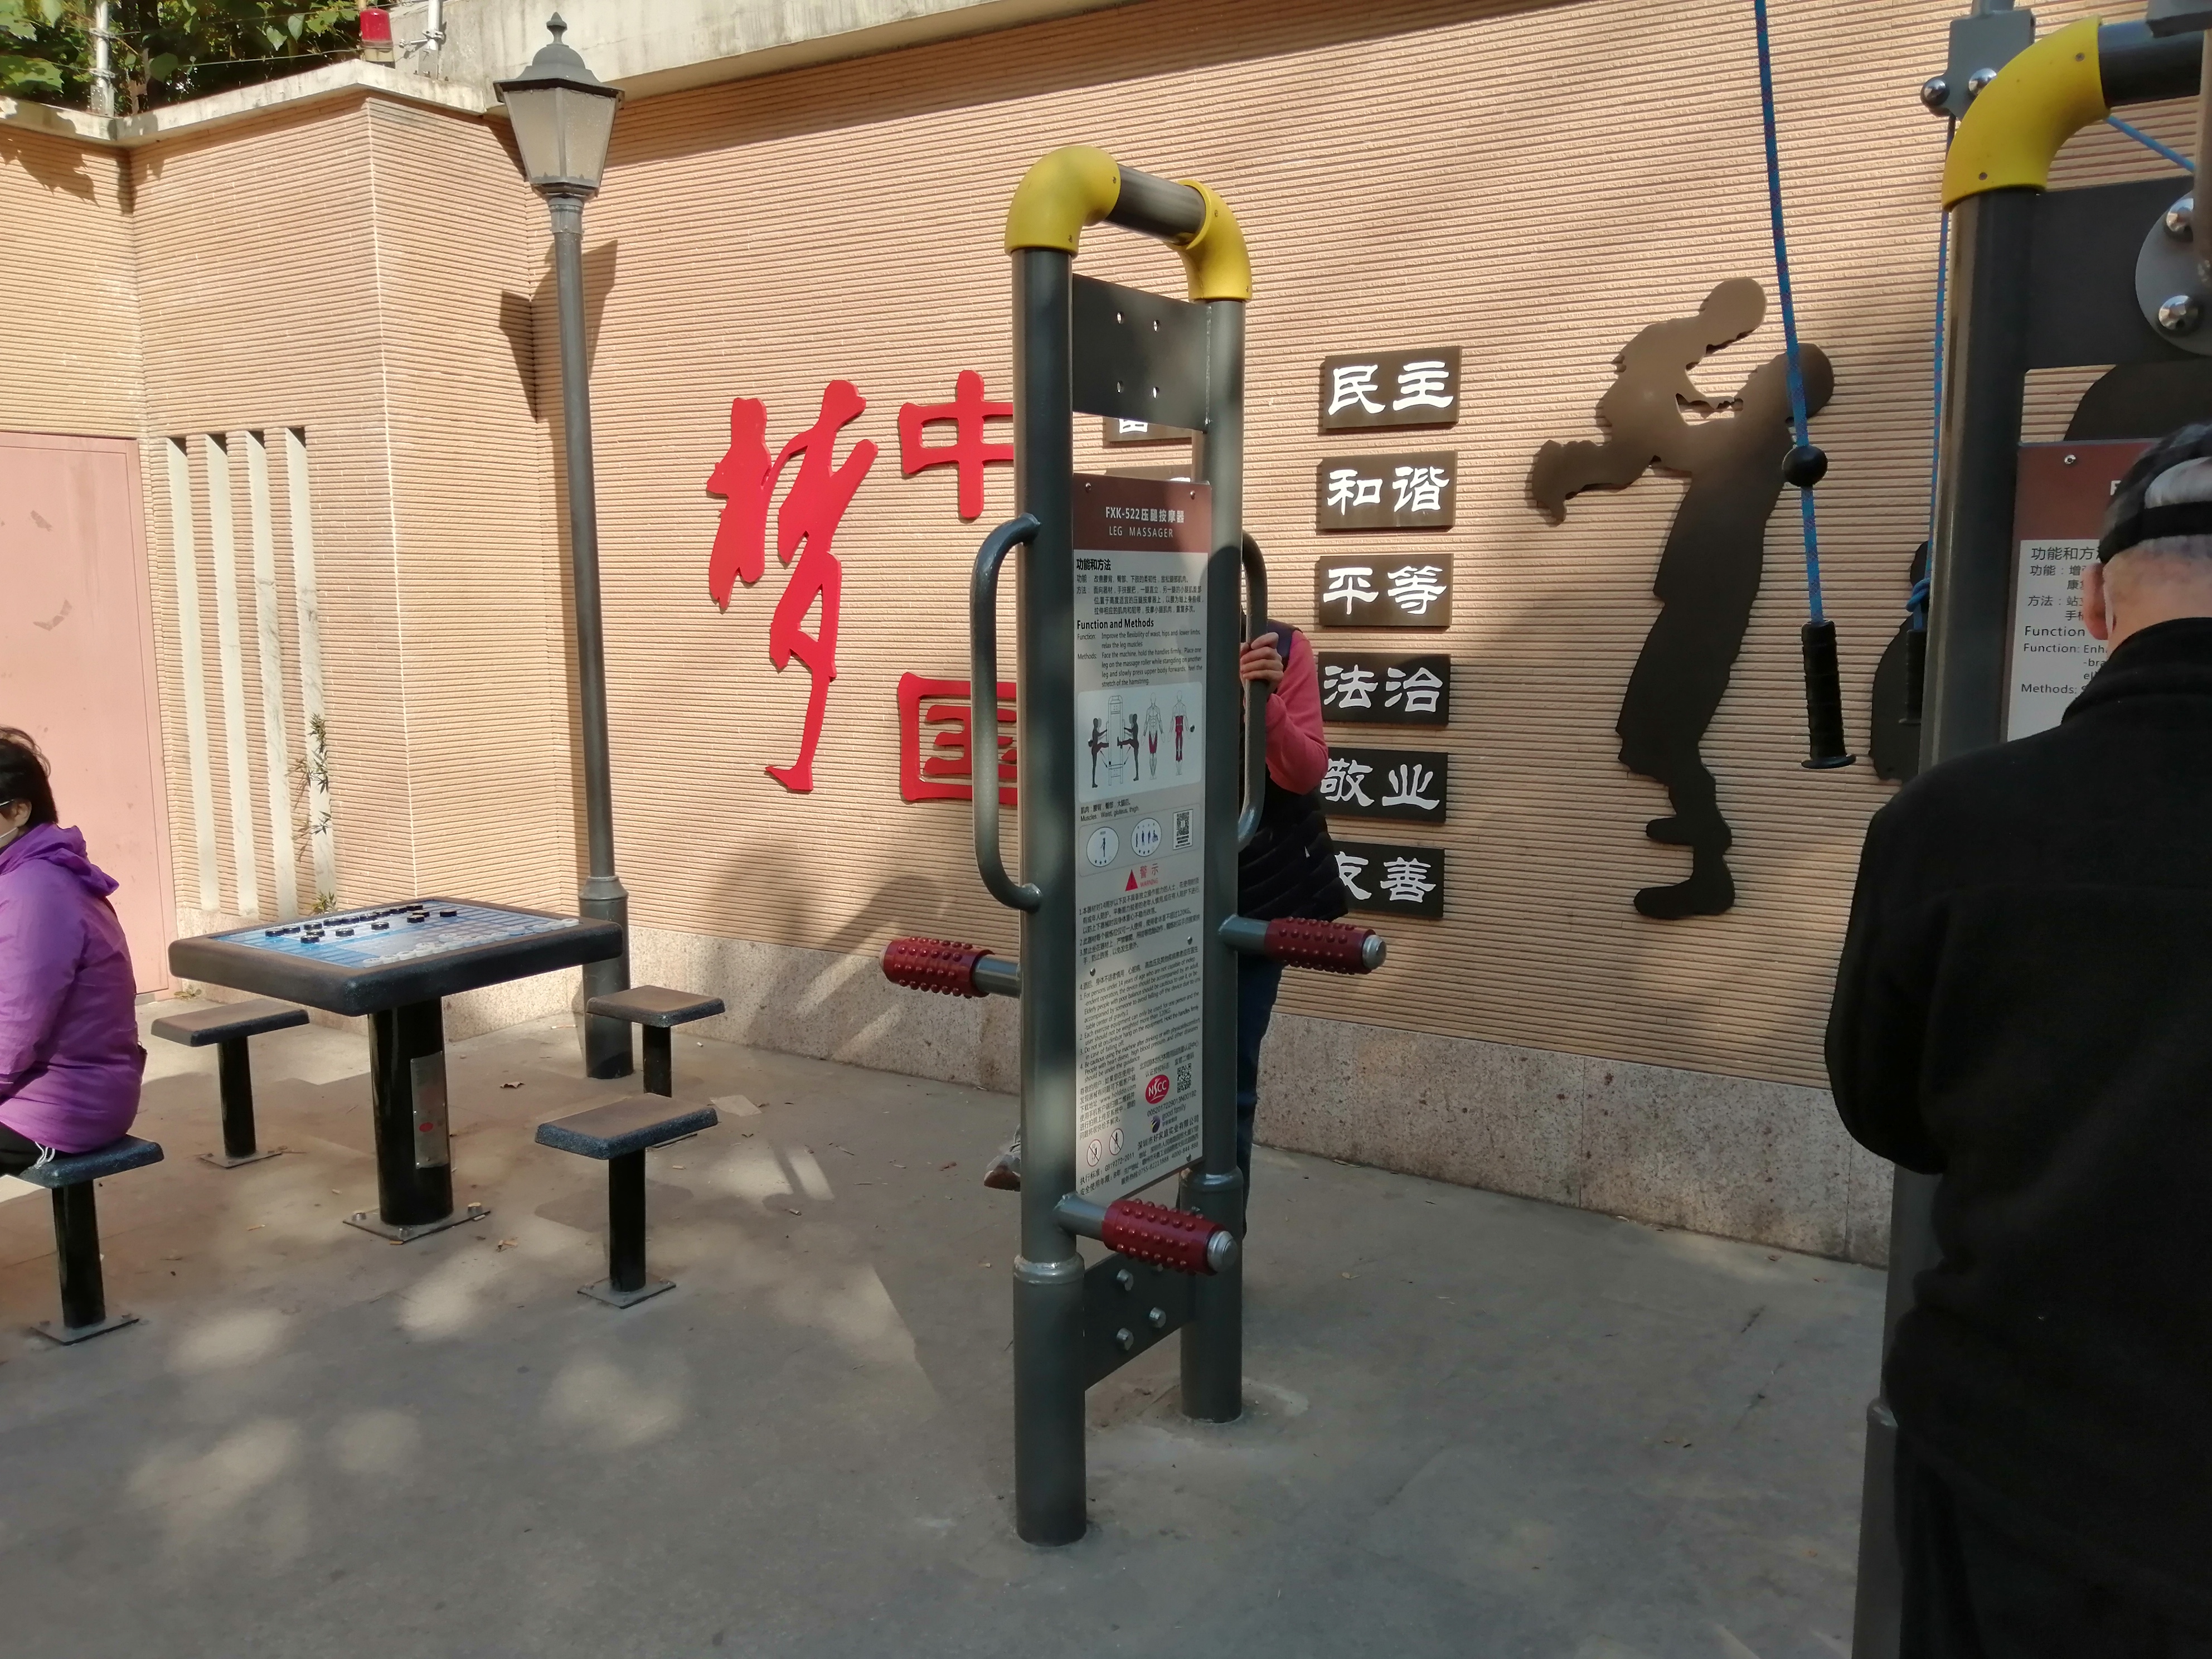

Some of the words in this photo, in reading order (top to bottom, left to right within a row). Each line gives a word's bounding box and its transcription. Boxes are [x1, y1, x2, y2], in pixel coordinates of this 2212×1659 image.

[1328, 361, 1453, 415] 民主
[1327, 466, 1449, 515] 和谐
[1109, 526, 1122, 536] LEG
[1129, 526, 1173, 537] MASSAGER
[2031, 546, 2100, 560] 功能和方
[1076, 558, 1111, 570] 功能和方法
[2069, 565, 2087, 576] 增
[1323, 566, 1447, 615] 平等
[1077, 619, 1108, 630] Function
[1109, 618, 1122, 628] and
[1124, 617, 1153, 628] Methods
[1101, 632, 1118, 641] Improve
[2025, 626, 2085, 637] Function
[2024, 643, 2080, 653] Function:
[2084, 644, 2108, 653] Enh
[1118, 670, 1131, 678] slowly
[1323, 664, 1443, 712] 法治
[2021, 683, 2077, 694] Methods:
[1320, 758, 1439, 810] 敬业
[1140, 861, 1158, 879] 警示
[1140, 877, 1158, 887] WARNING
[1335, 851, 1436, 903] 友善
[1091, 987, 1105, 997] persons
[1084, 1006, 1096, 1016] Elderly
[1097, 1001, 1109, 1011] people
[1115, 1002, 1132, 1011] someone
[1096, 1017, 1108, 1026] center
[1084, 1030, 1093, 1038] Each
[1095, 1024, 1109, 1034] exercise
[1095, 1032, 1107, 1041] should
[1123, 1030, 1132, 1039] hang
[1085, 1065, 1097, 1075] People
[1107, 1057, 1117, 1065] heart
[1139, 1044, 1150, 1052] blood
[1105, 1051, 1114, 1060] using
[1085, 1072, 1097, 1081] should
[1104, 1064, 1115, 1074] under
[1148, 1075, 1166, 1099] NSCC
[1162, 1108, 1173, 1120] good
[1173, 1102, 1186, 1115] family
[1104, 1151, 1134, 1171] GB19272-2011
